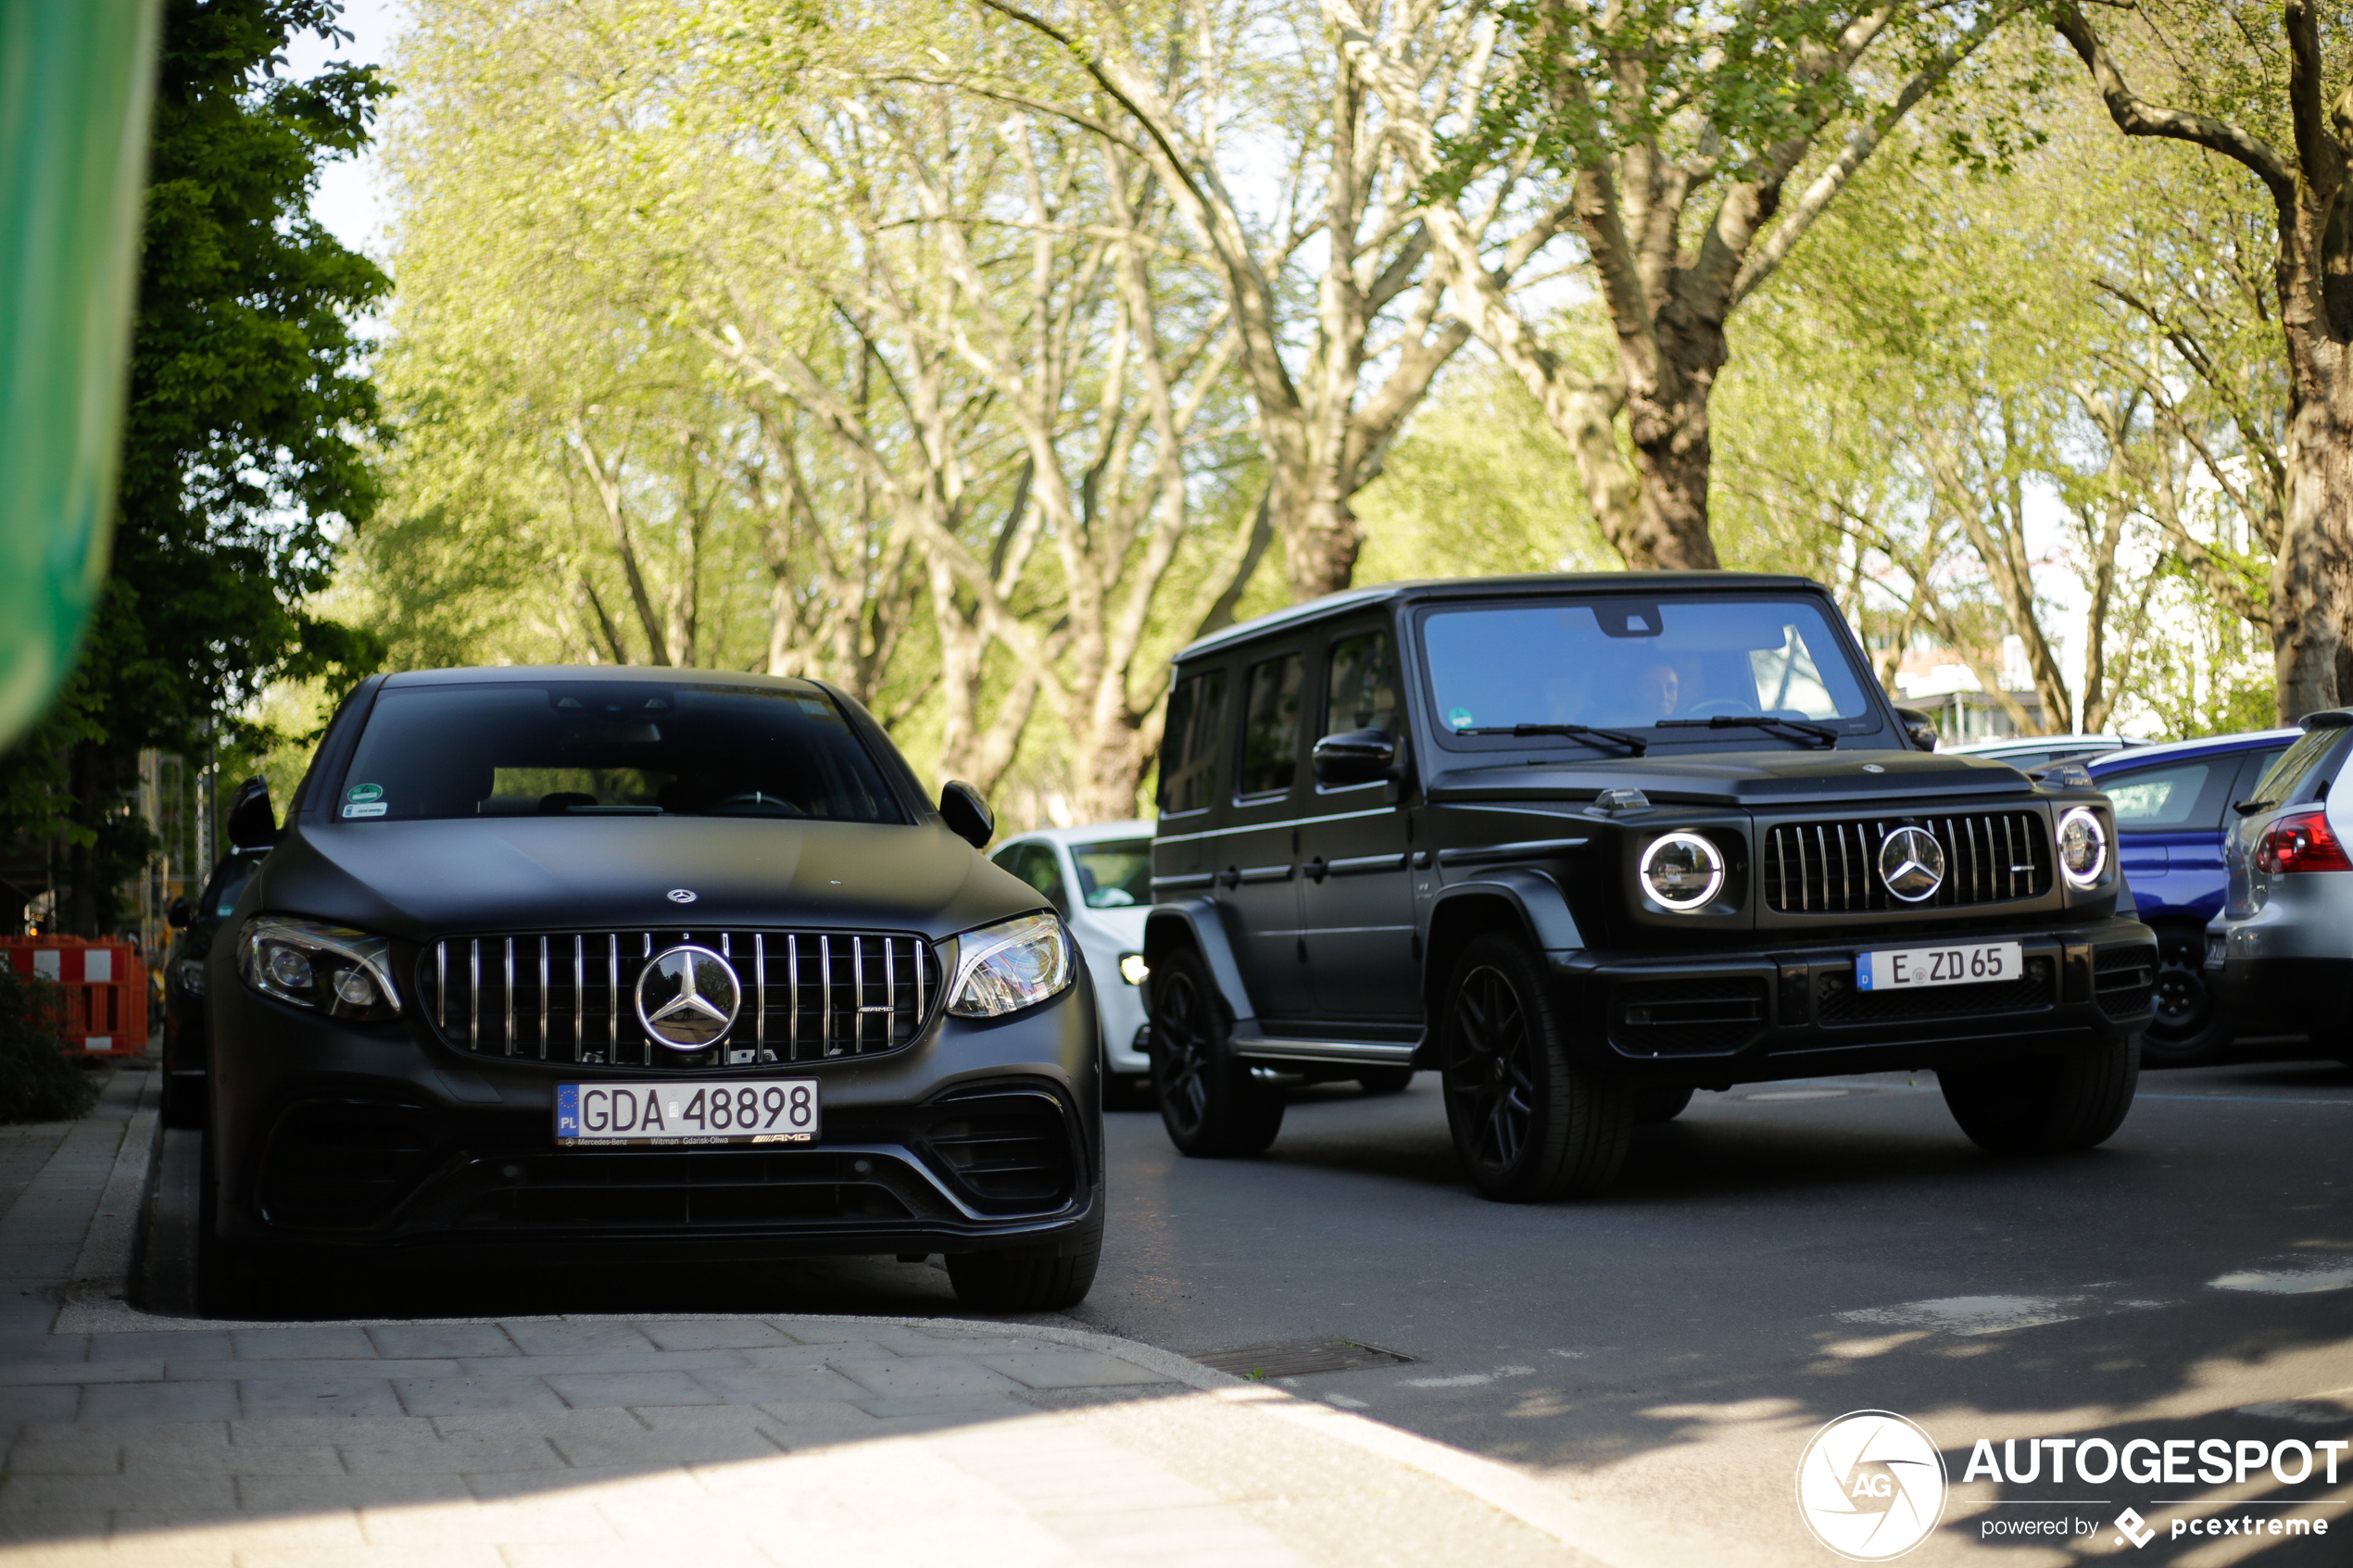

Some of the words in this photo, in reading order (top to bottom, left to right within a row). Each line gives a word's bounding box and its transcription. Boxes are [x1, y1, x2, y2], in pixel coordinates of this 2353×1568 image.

[1893, 954, 1910, 984] E
[1862, 975, 1869, 985] D
[584, 1088, 665, 1132] GDA
[683, 1085, 812, 1130] 48898
[560, 1117, 576, 1129] PL
[650, 1137, 679, 1146] Witman
[772, 1133, 812, 1142] AMG
